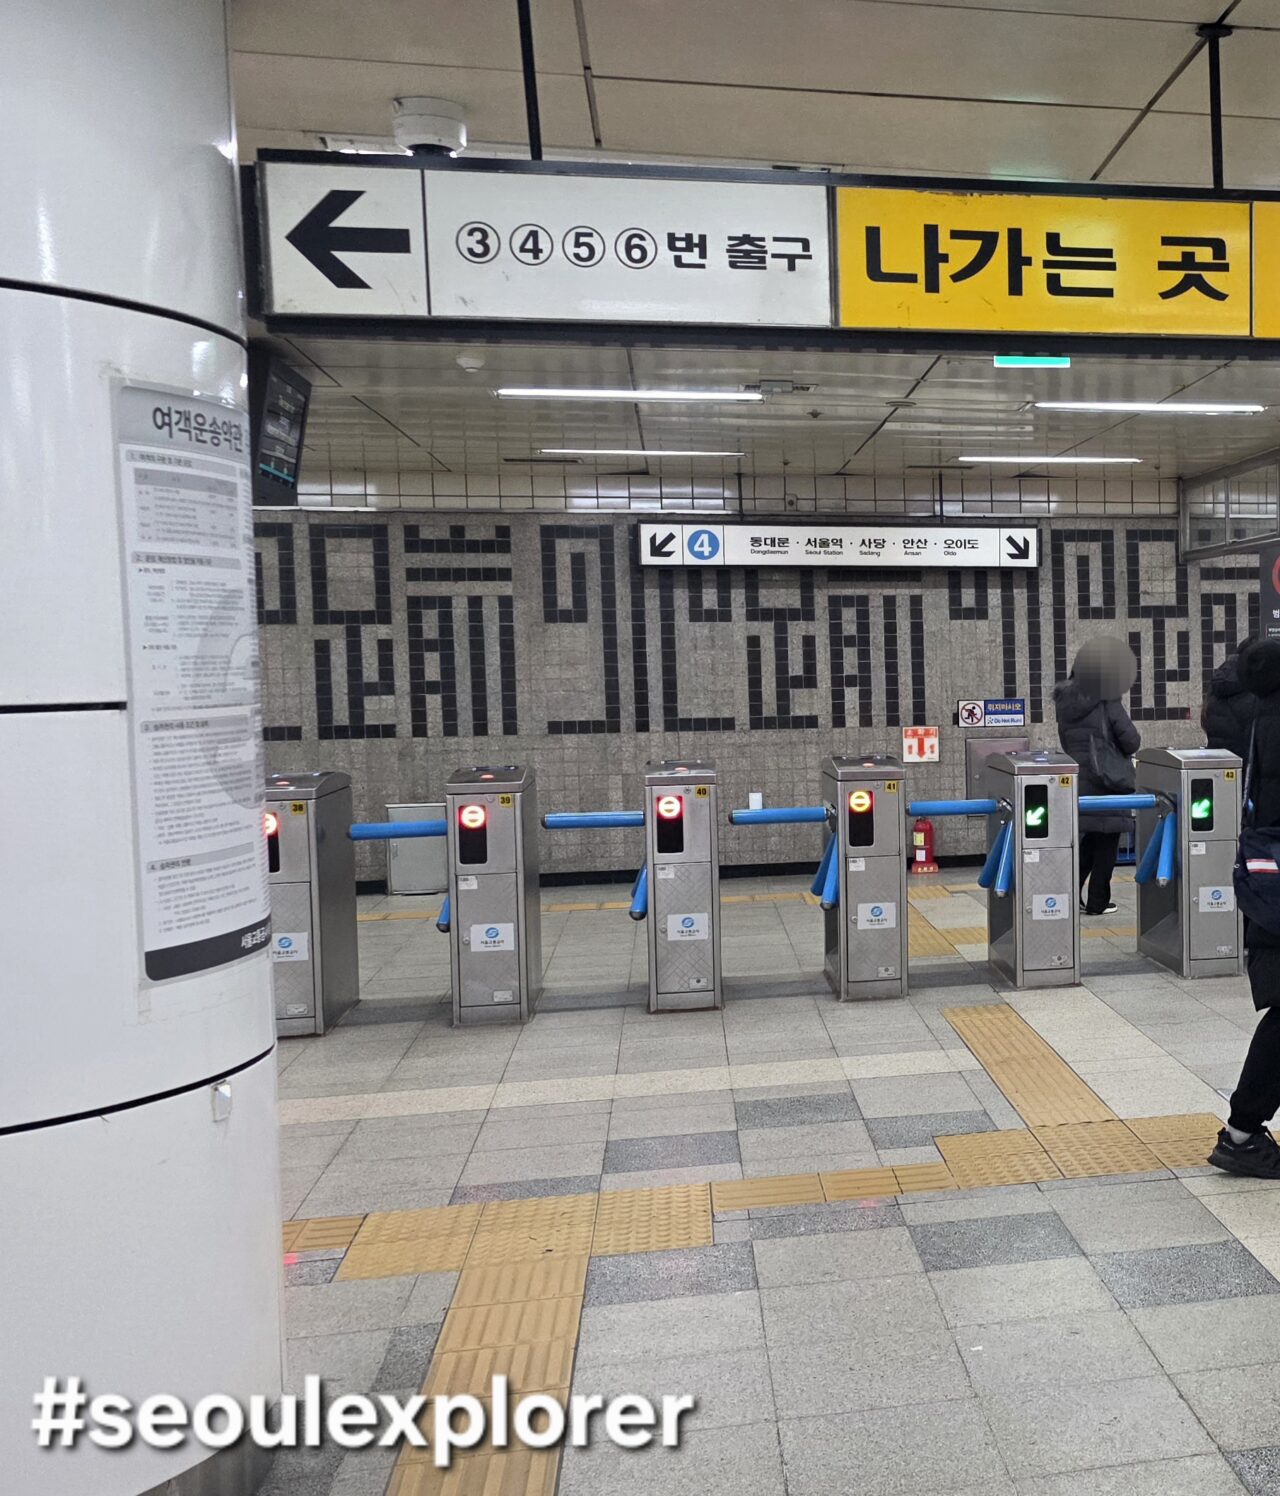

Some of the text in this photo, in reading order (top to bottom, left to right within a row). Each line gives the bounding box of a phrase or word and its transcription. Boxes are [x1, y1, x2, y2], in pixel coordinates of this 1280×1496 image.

[725, 233, 813, 272] 출구
[865, 224, 1230, 301] 나가는 곳
[152, 406, 243, 453] 여객운송약관
[692, 533, 713, 557] 4
[749, 536, 979, 551] 동대문 서울역 사당 안산 오이도
[1225, 771, 1234, 780] 43
[1060, 776, 1070, 785] 42
[886, 782, 896, 791] 41
[696, 787, 707, 796] 40
[500, 795, 511, 804] 39
[292, 803, 304, 812] 38
